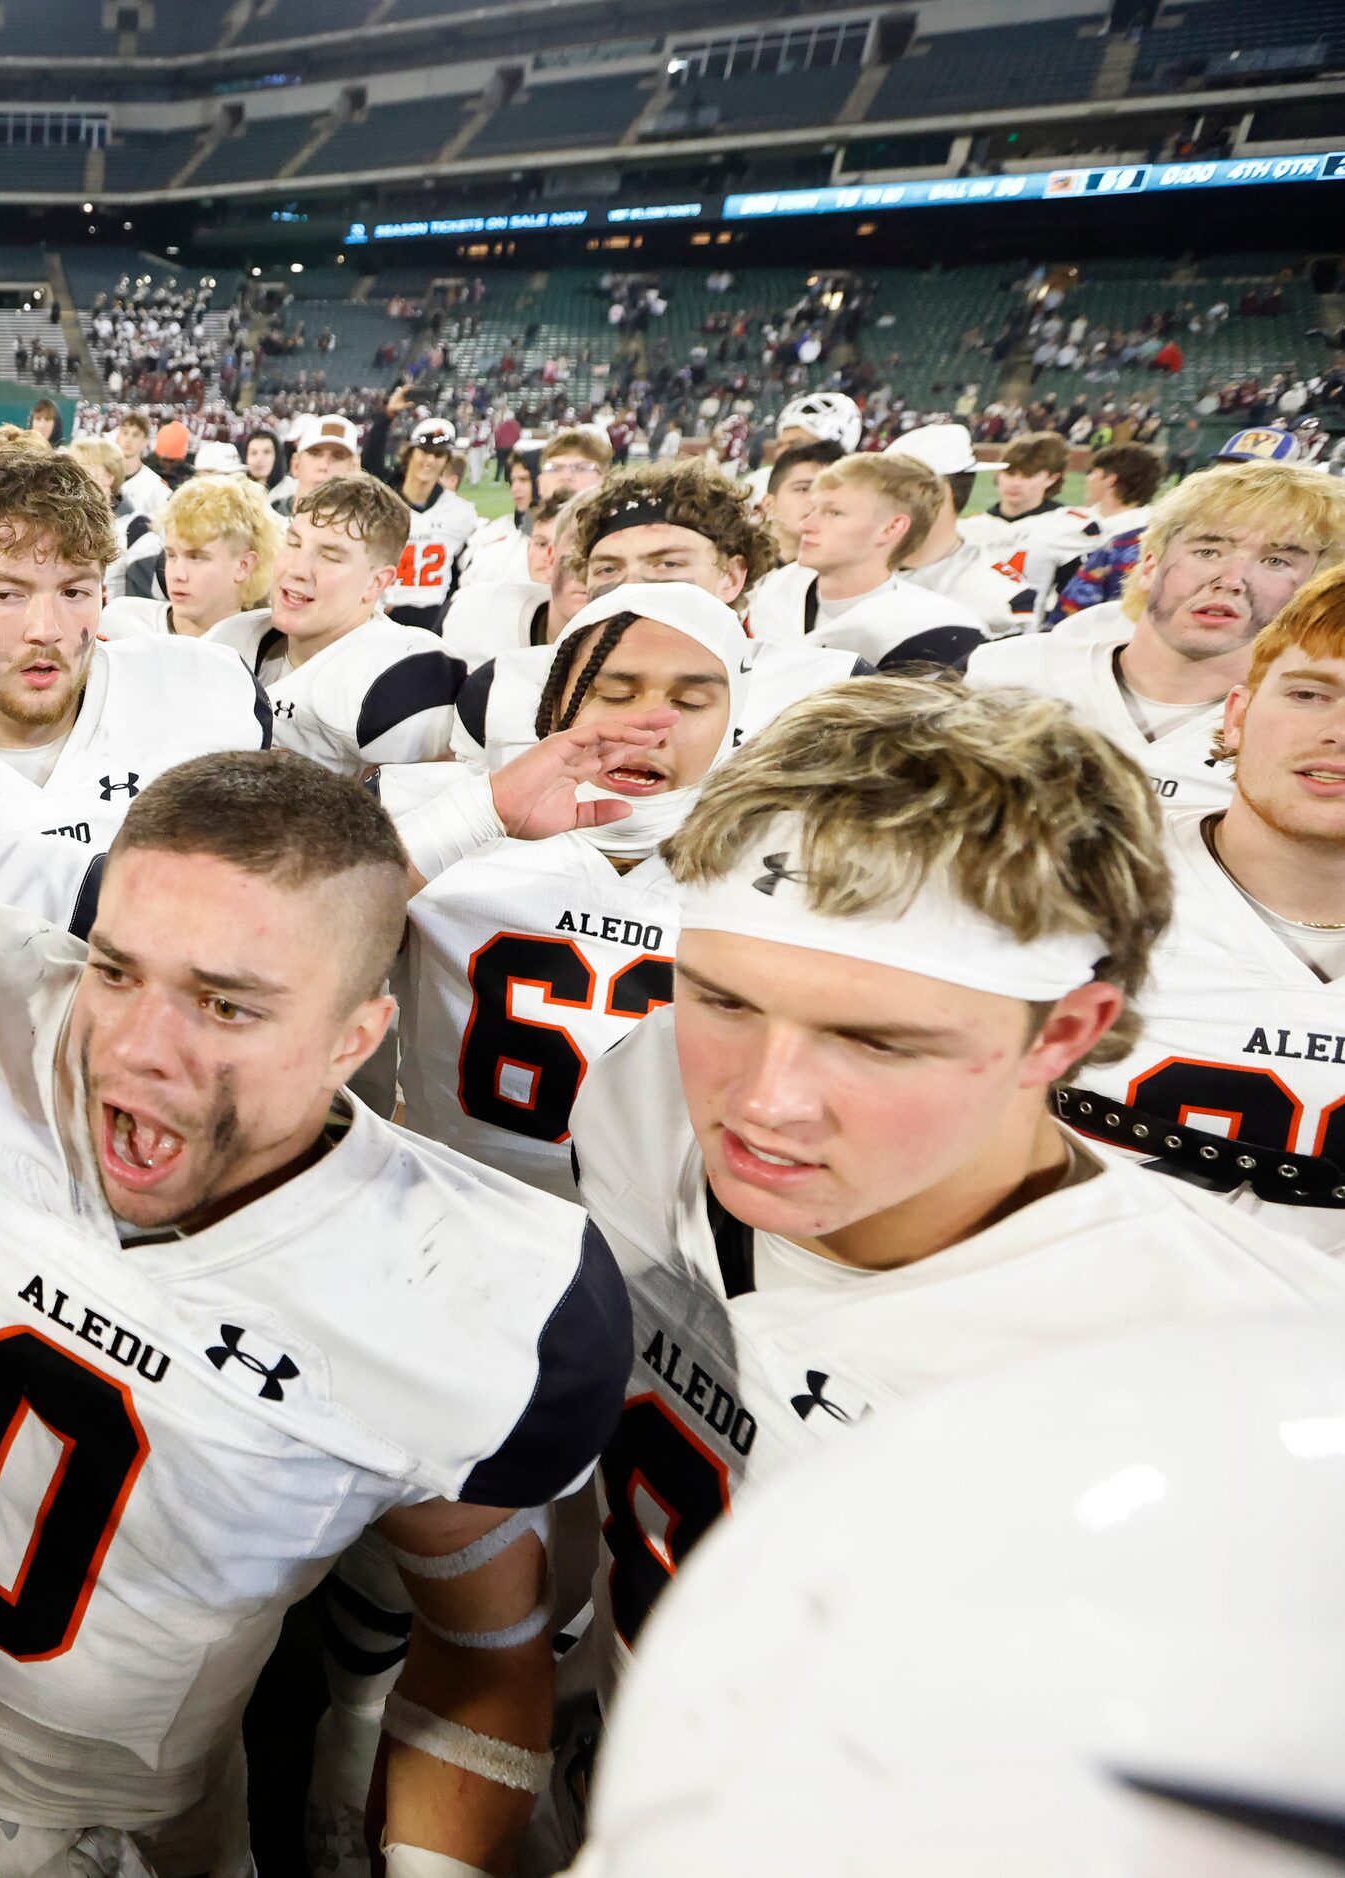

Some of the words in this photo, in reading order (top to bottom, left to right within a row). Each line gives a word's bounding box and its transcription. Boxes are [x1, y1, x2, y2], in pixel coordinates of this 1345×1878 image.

[1159, 163, 1217, 186] 0:00
[1227, 161, 1275, 180] 4TH
[1272, 158, 1319, 179] QTR
[373, 222, 428, 239] SEASON
[429, 217, 485, 234] TICKETS
[485, 215, 508, 231] ON
[508, 213, 549, 229] SALE
[549, 210, 588, 226] NOW
[397, 543, 447, 587] 42
[555, 910, 663, 951] ALEDO
[18, 1275, 170, 1383] ALEDO
[642, 1329, 758, 1456] ALEDO
